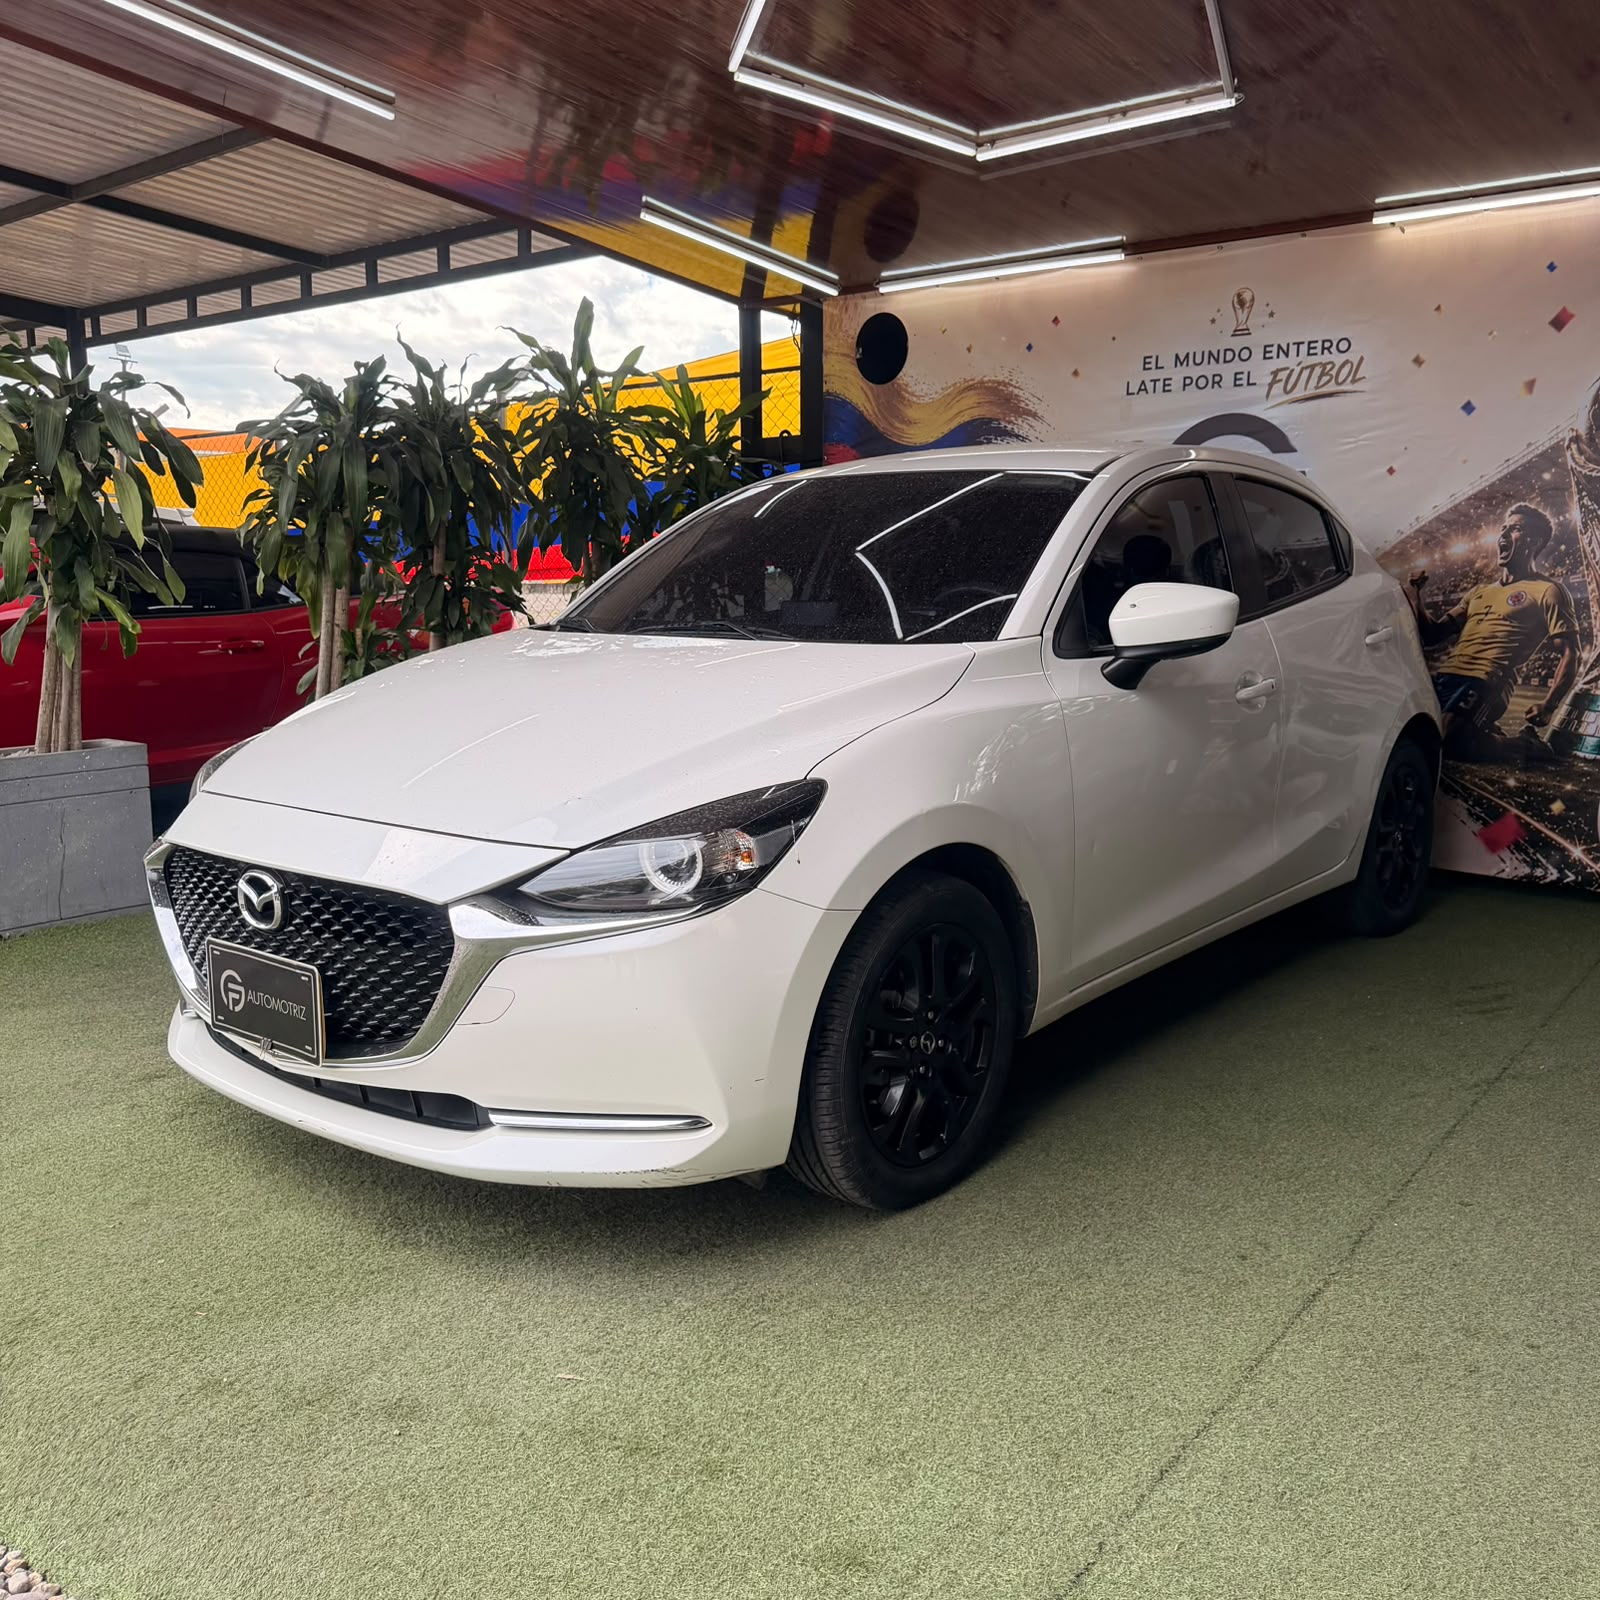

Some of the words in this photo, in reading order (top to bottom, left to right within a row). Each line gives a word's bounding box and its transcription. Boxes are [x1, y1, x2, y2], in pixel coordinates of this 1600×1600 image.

[1142, 355, 1164, 371] EL
[1174, 346, 1252, 368] MUNDO
[1262, 337, 1352, 361] ENTERO
[1126, 377, 1172, 396] LATE
[1182, 374, 1223, 392] POR
[1233, 372, 1257, 387] EL
[1265, 355, 1367, 400] FÚTBOL
[247, 989, 307, 1021] AUTOMOTRIZ
